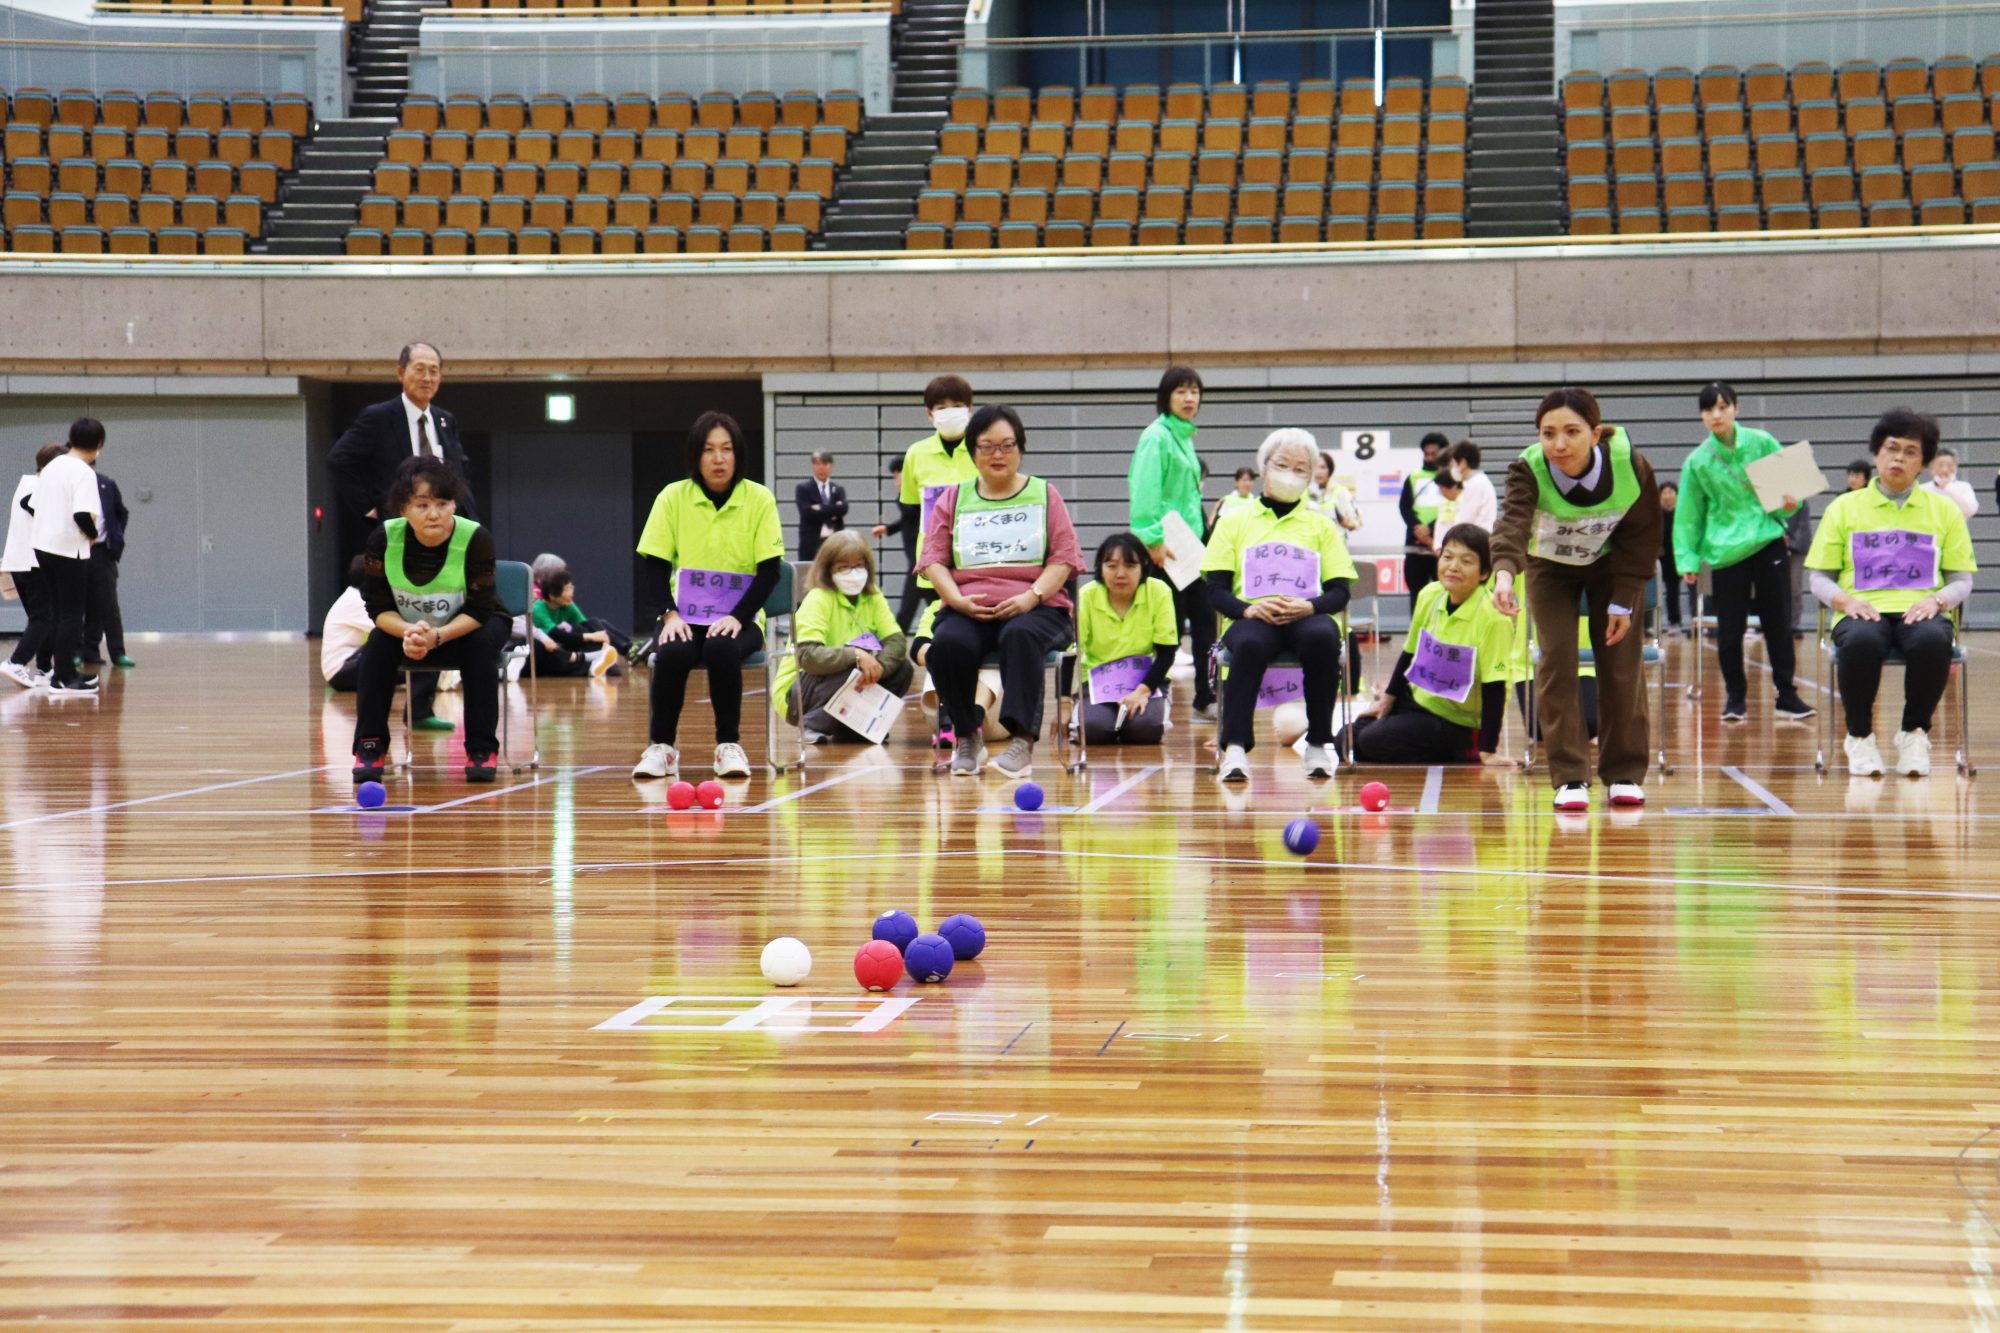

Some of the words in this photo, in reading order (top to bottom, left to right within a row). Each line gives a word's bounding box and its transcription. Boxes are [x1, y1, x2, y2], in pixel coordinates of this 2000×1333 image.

[1355, 433, 1375, 460] 8
[1255, 545, 1306, 560] 紀の里
[690, 572, 744, 590] 紀の里
[1379, 567, 1392, 584] 0
[398, 595, 450, 613] みくまの
[687, 604, 729, 618] Dチー
